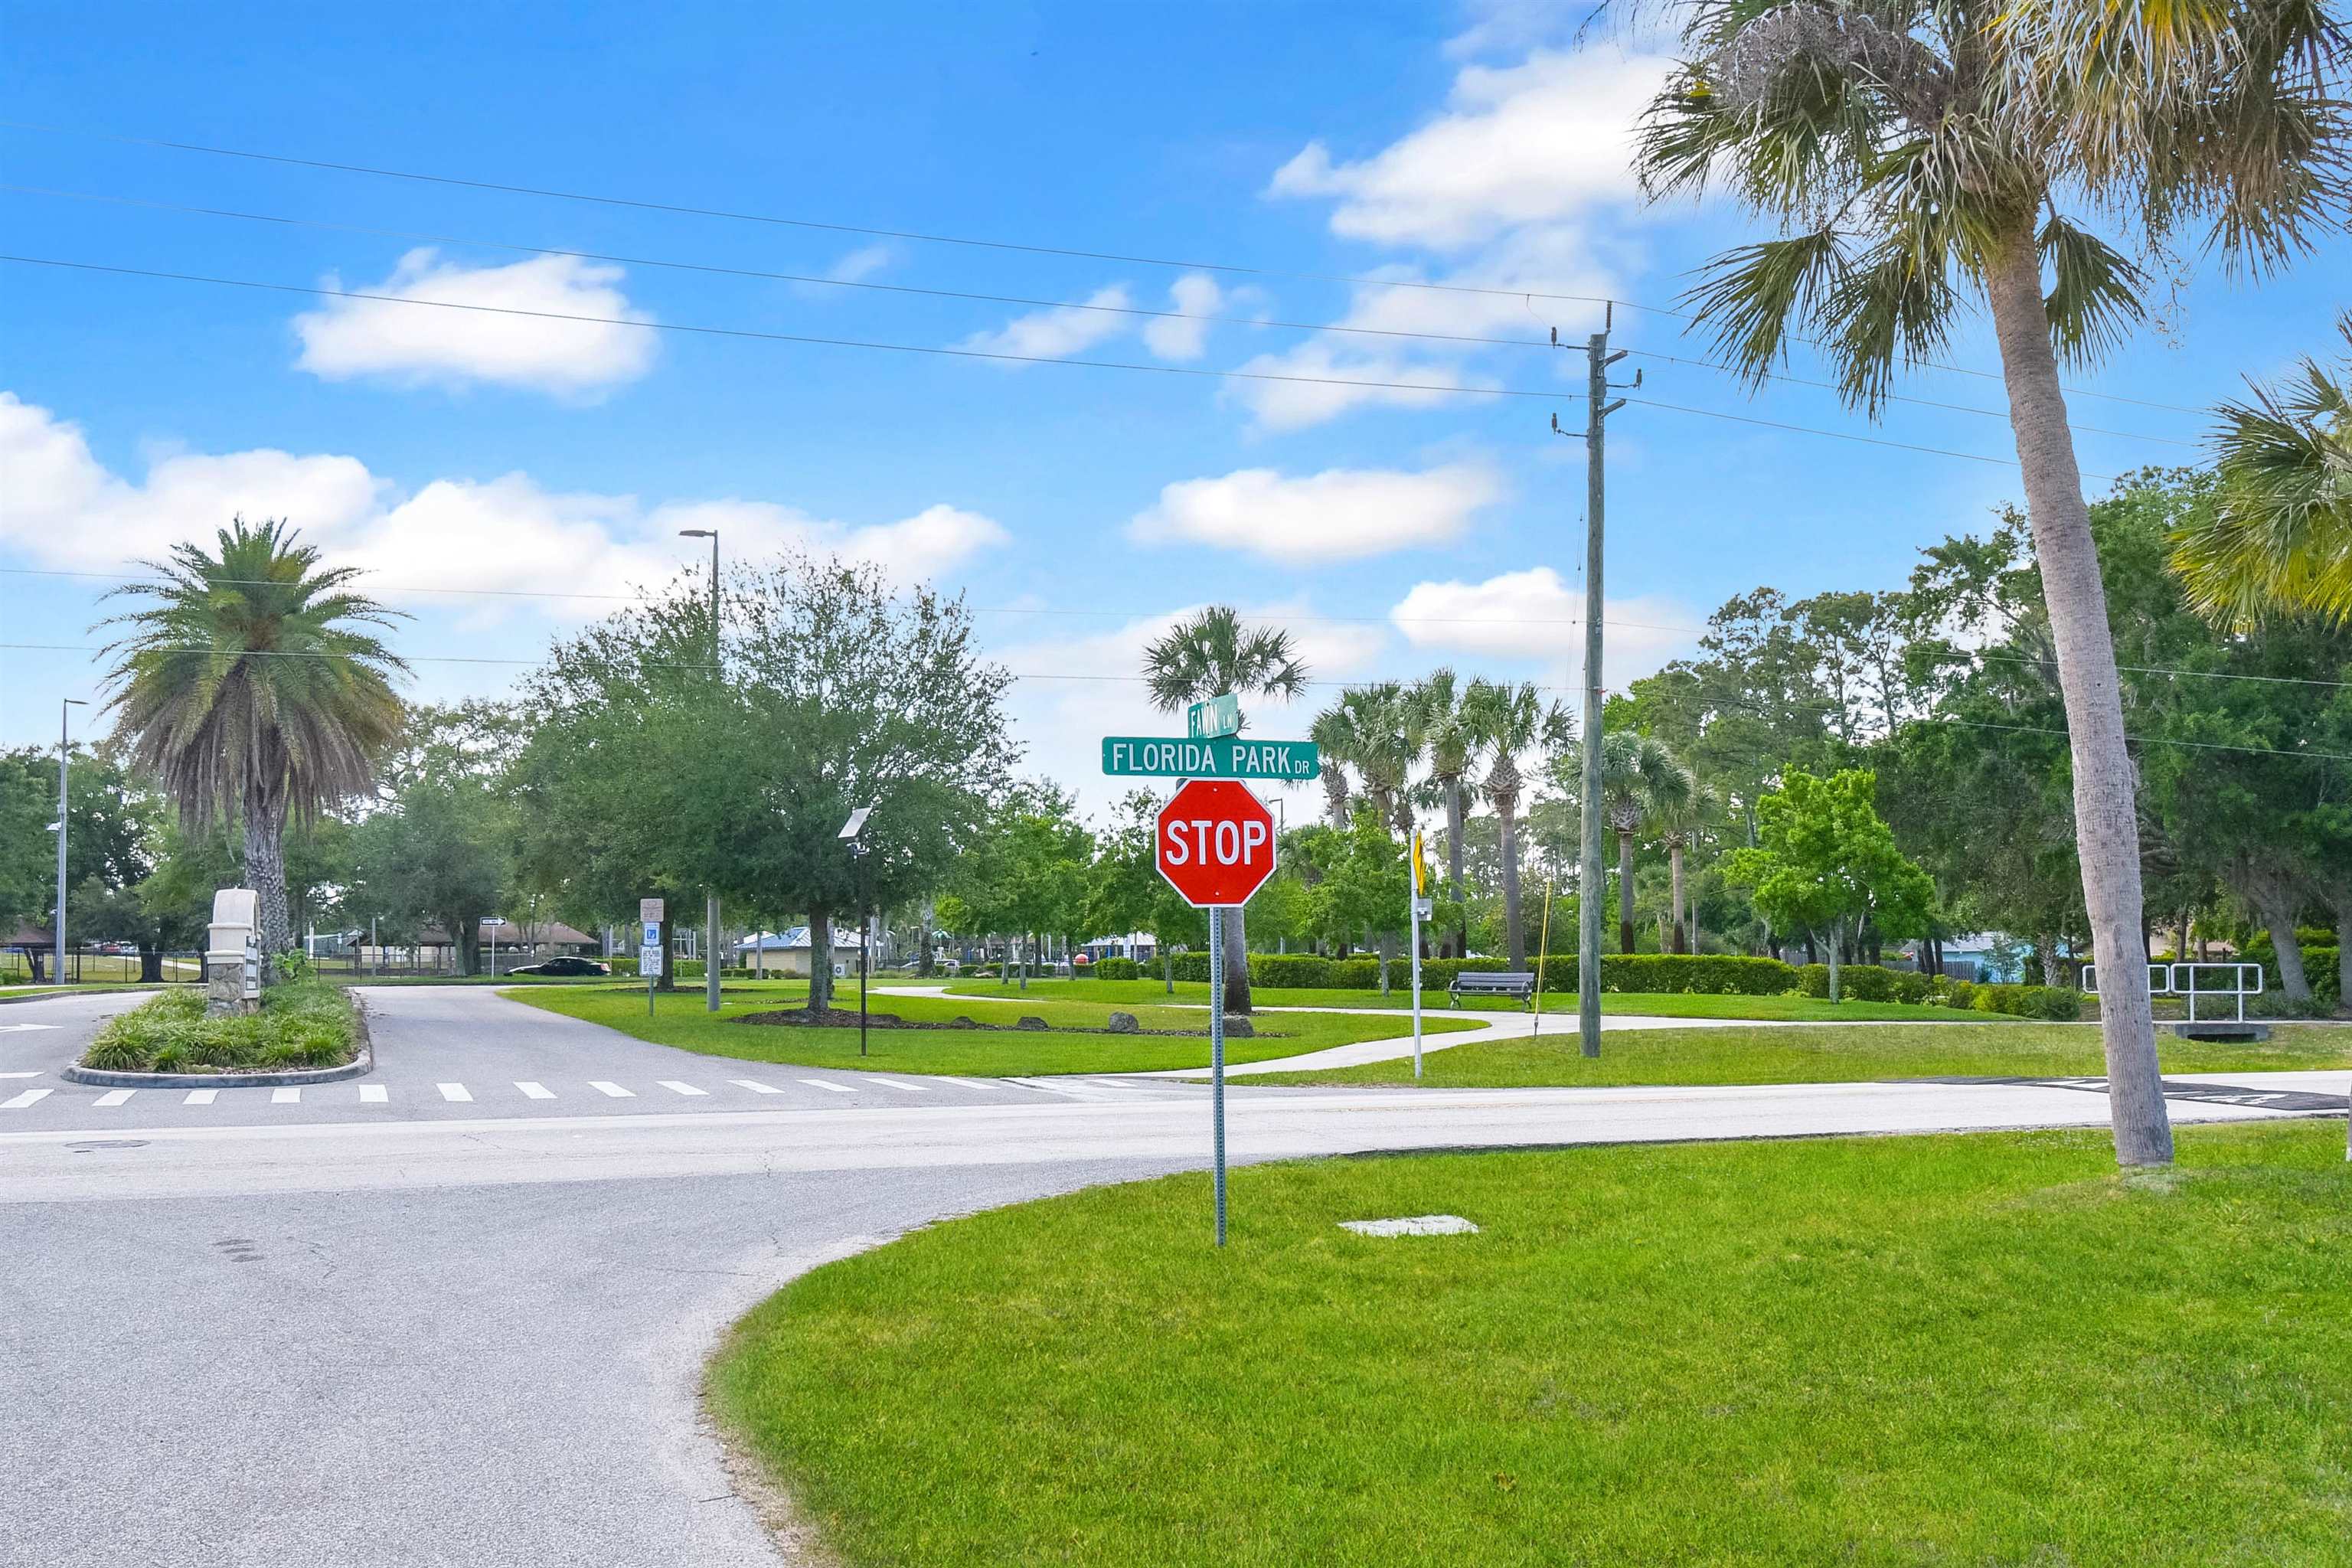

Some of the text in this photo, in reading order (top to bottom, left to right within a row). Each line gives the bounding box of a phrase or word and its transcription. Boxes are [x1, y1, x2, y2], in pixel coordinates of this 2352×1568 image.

[1191, 704, 1232, 738] FAWN LN
[1113, 743, 1310, 774] FLORIDA PARK DR
[1165, 820, 1266, 865] STOP
